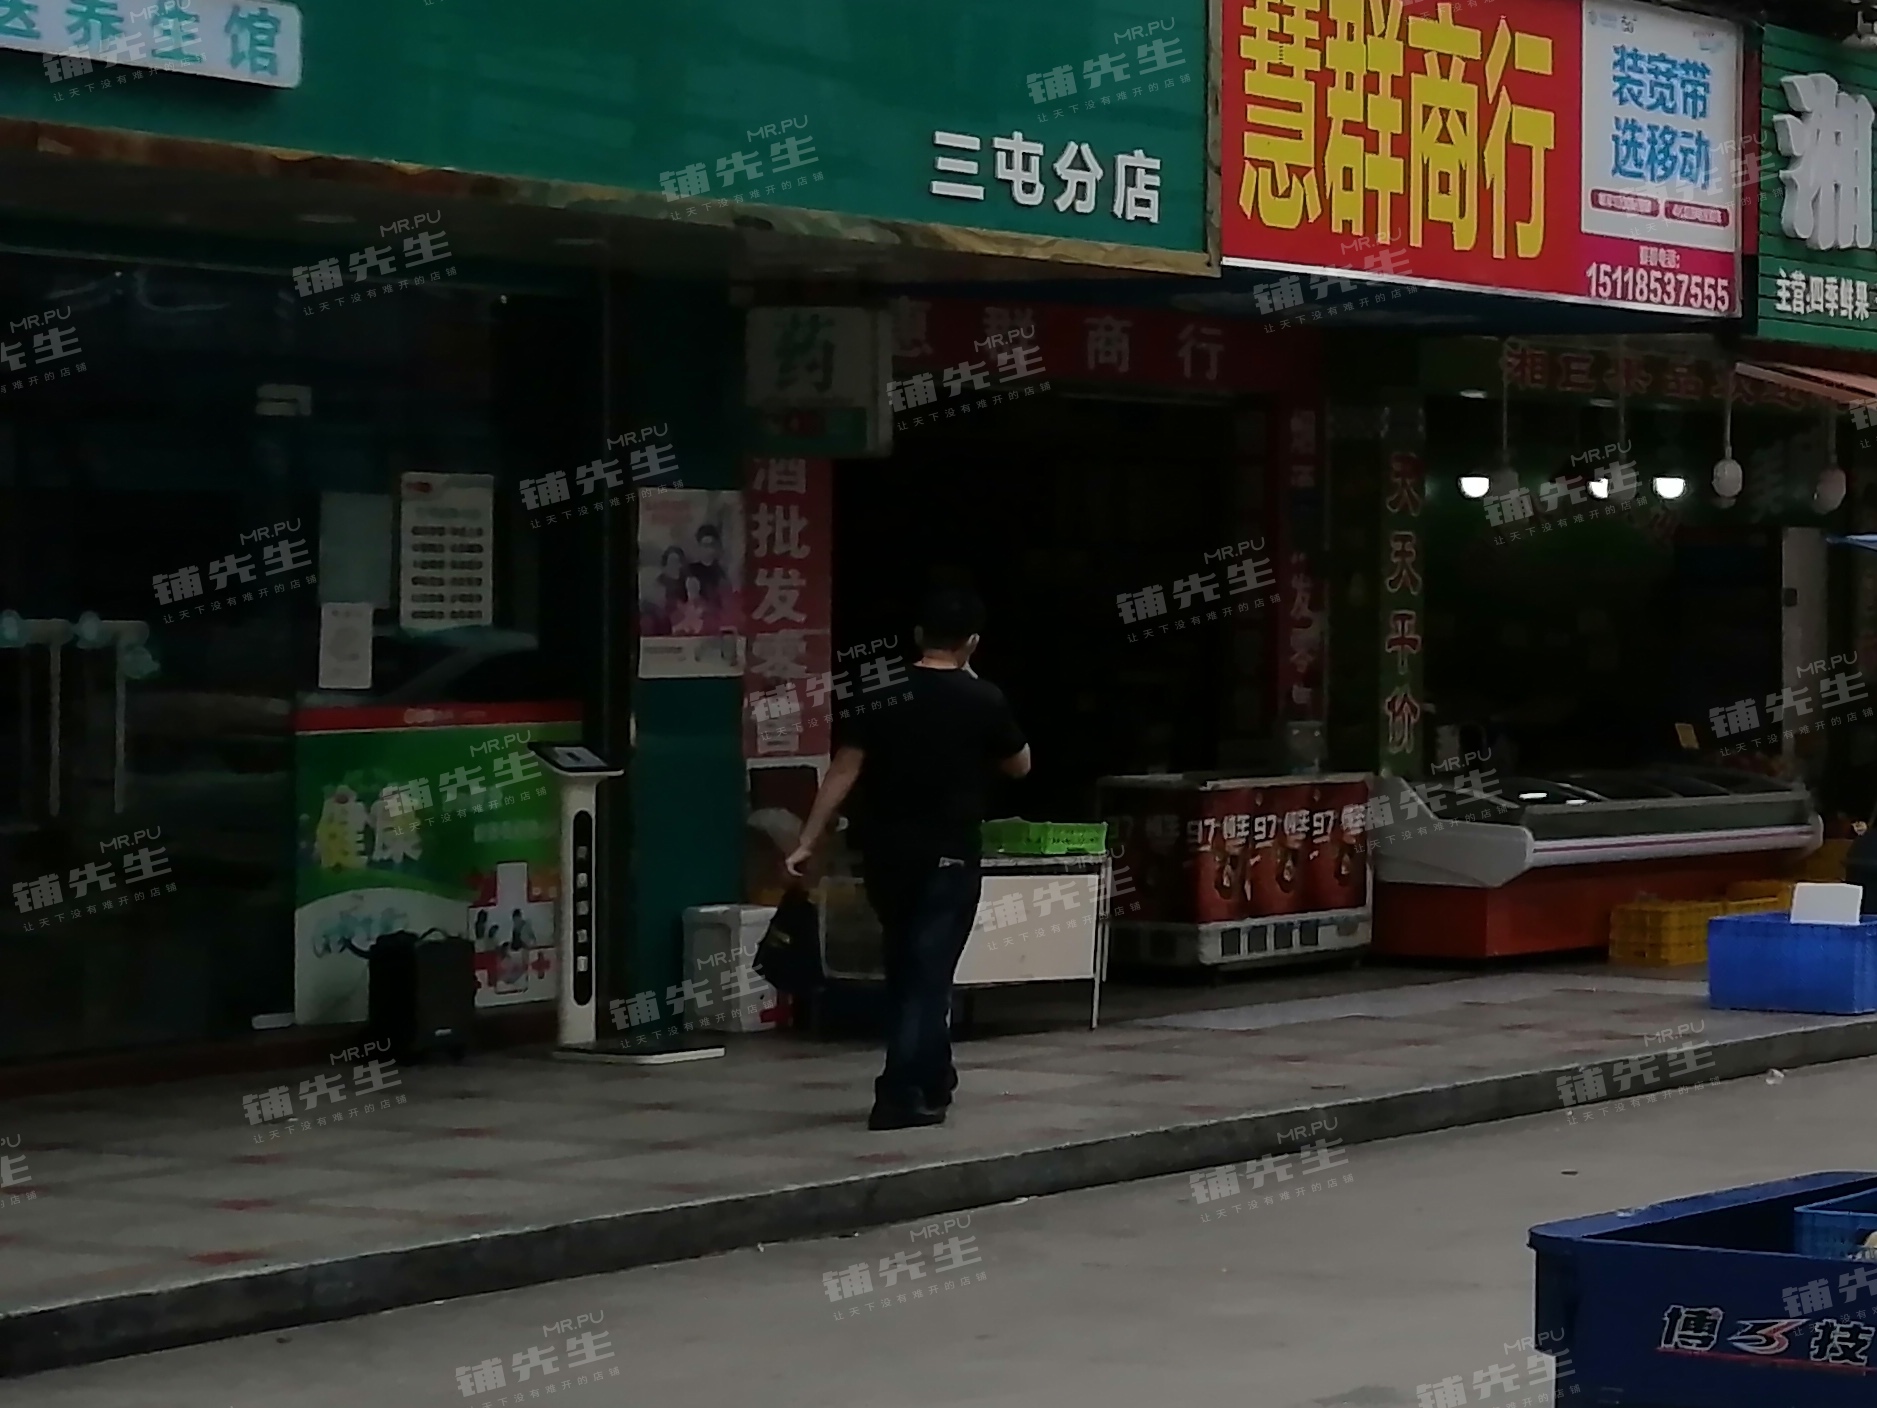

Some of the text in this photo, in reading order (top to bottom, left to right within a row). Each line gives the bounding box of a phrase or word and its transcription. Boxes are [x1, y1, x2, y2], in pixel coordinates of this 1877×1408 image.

[1611, 43, 1711, 121] 装宽带
[931, 130, 1162, 224] 三屯分店
[1611, 114, 1711, 191] 选移动
[1585, 261, 1731, 313] 15118537555
